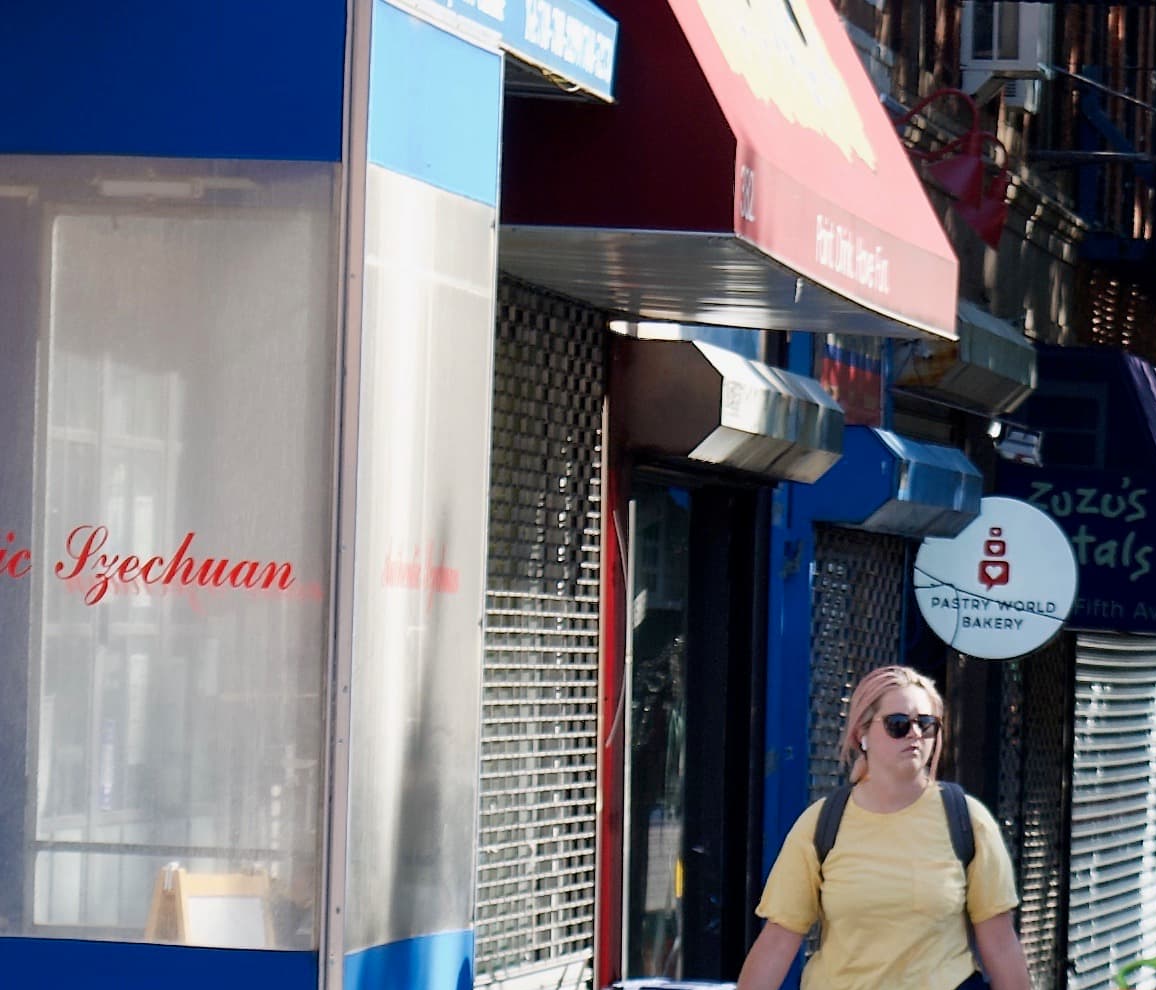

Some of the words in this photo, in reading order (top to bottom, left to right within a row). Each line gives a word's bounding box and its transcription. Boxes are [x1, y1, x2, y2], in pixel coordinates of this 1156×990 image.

[1028, 477, 1148, 522] Zuzu's
[54, 524, 296, 606] Szechuan
[1072, 524, 1153, 581] tals
[931, 597, 989, 611] PASTRY
[999, 600, 1056, 613] WORLD
[962, 618, 1023, 630] BAKERY
